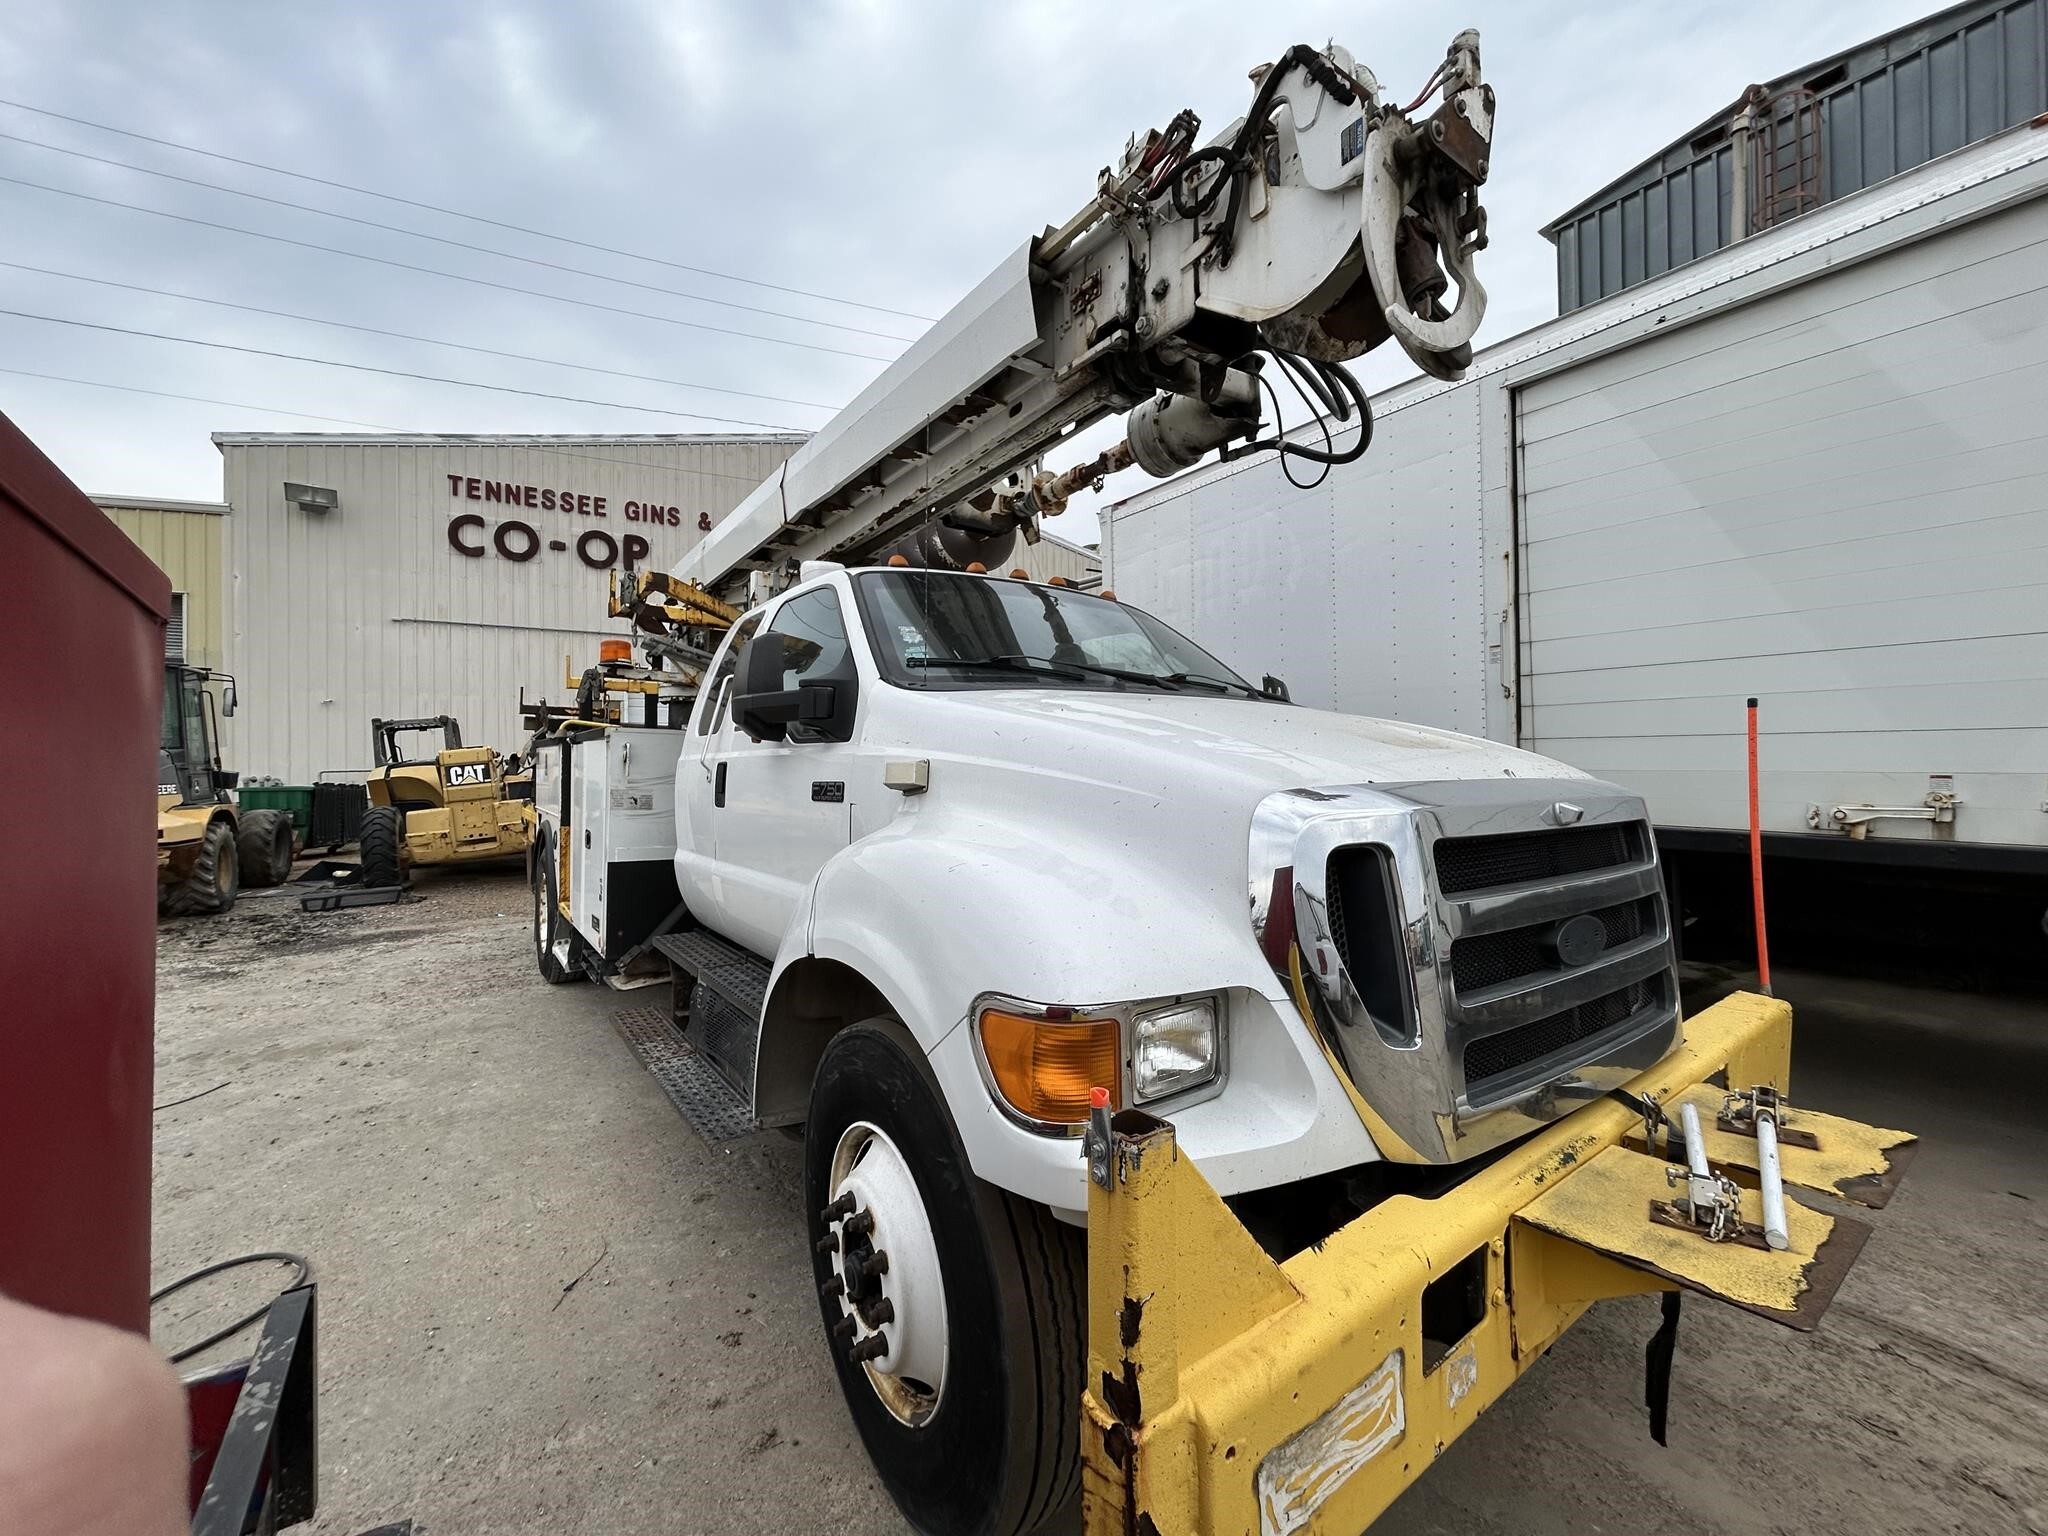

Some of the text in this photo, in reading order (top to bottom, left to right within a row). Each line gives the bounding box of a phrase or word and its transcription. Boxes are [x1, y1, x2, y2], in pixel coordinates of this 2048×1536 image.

[448, 474, 712, 531] TENNESSEE GINS &
[448, 514, 649, 571] CO-OP
[450, 764, 485, 785] CAT
